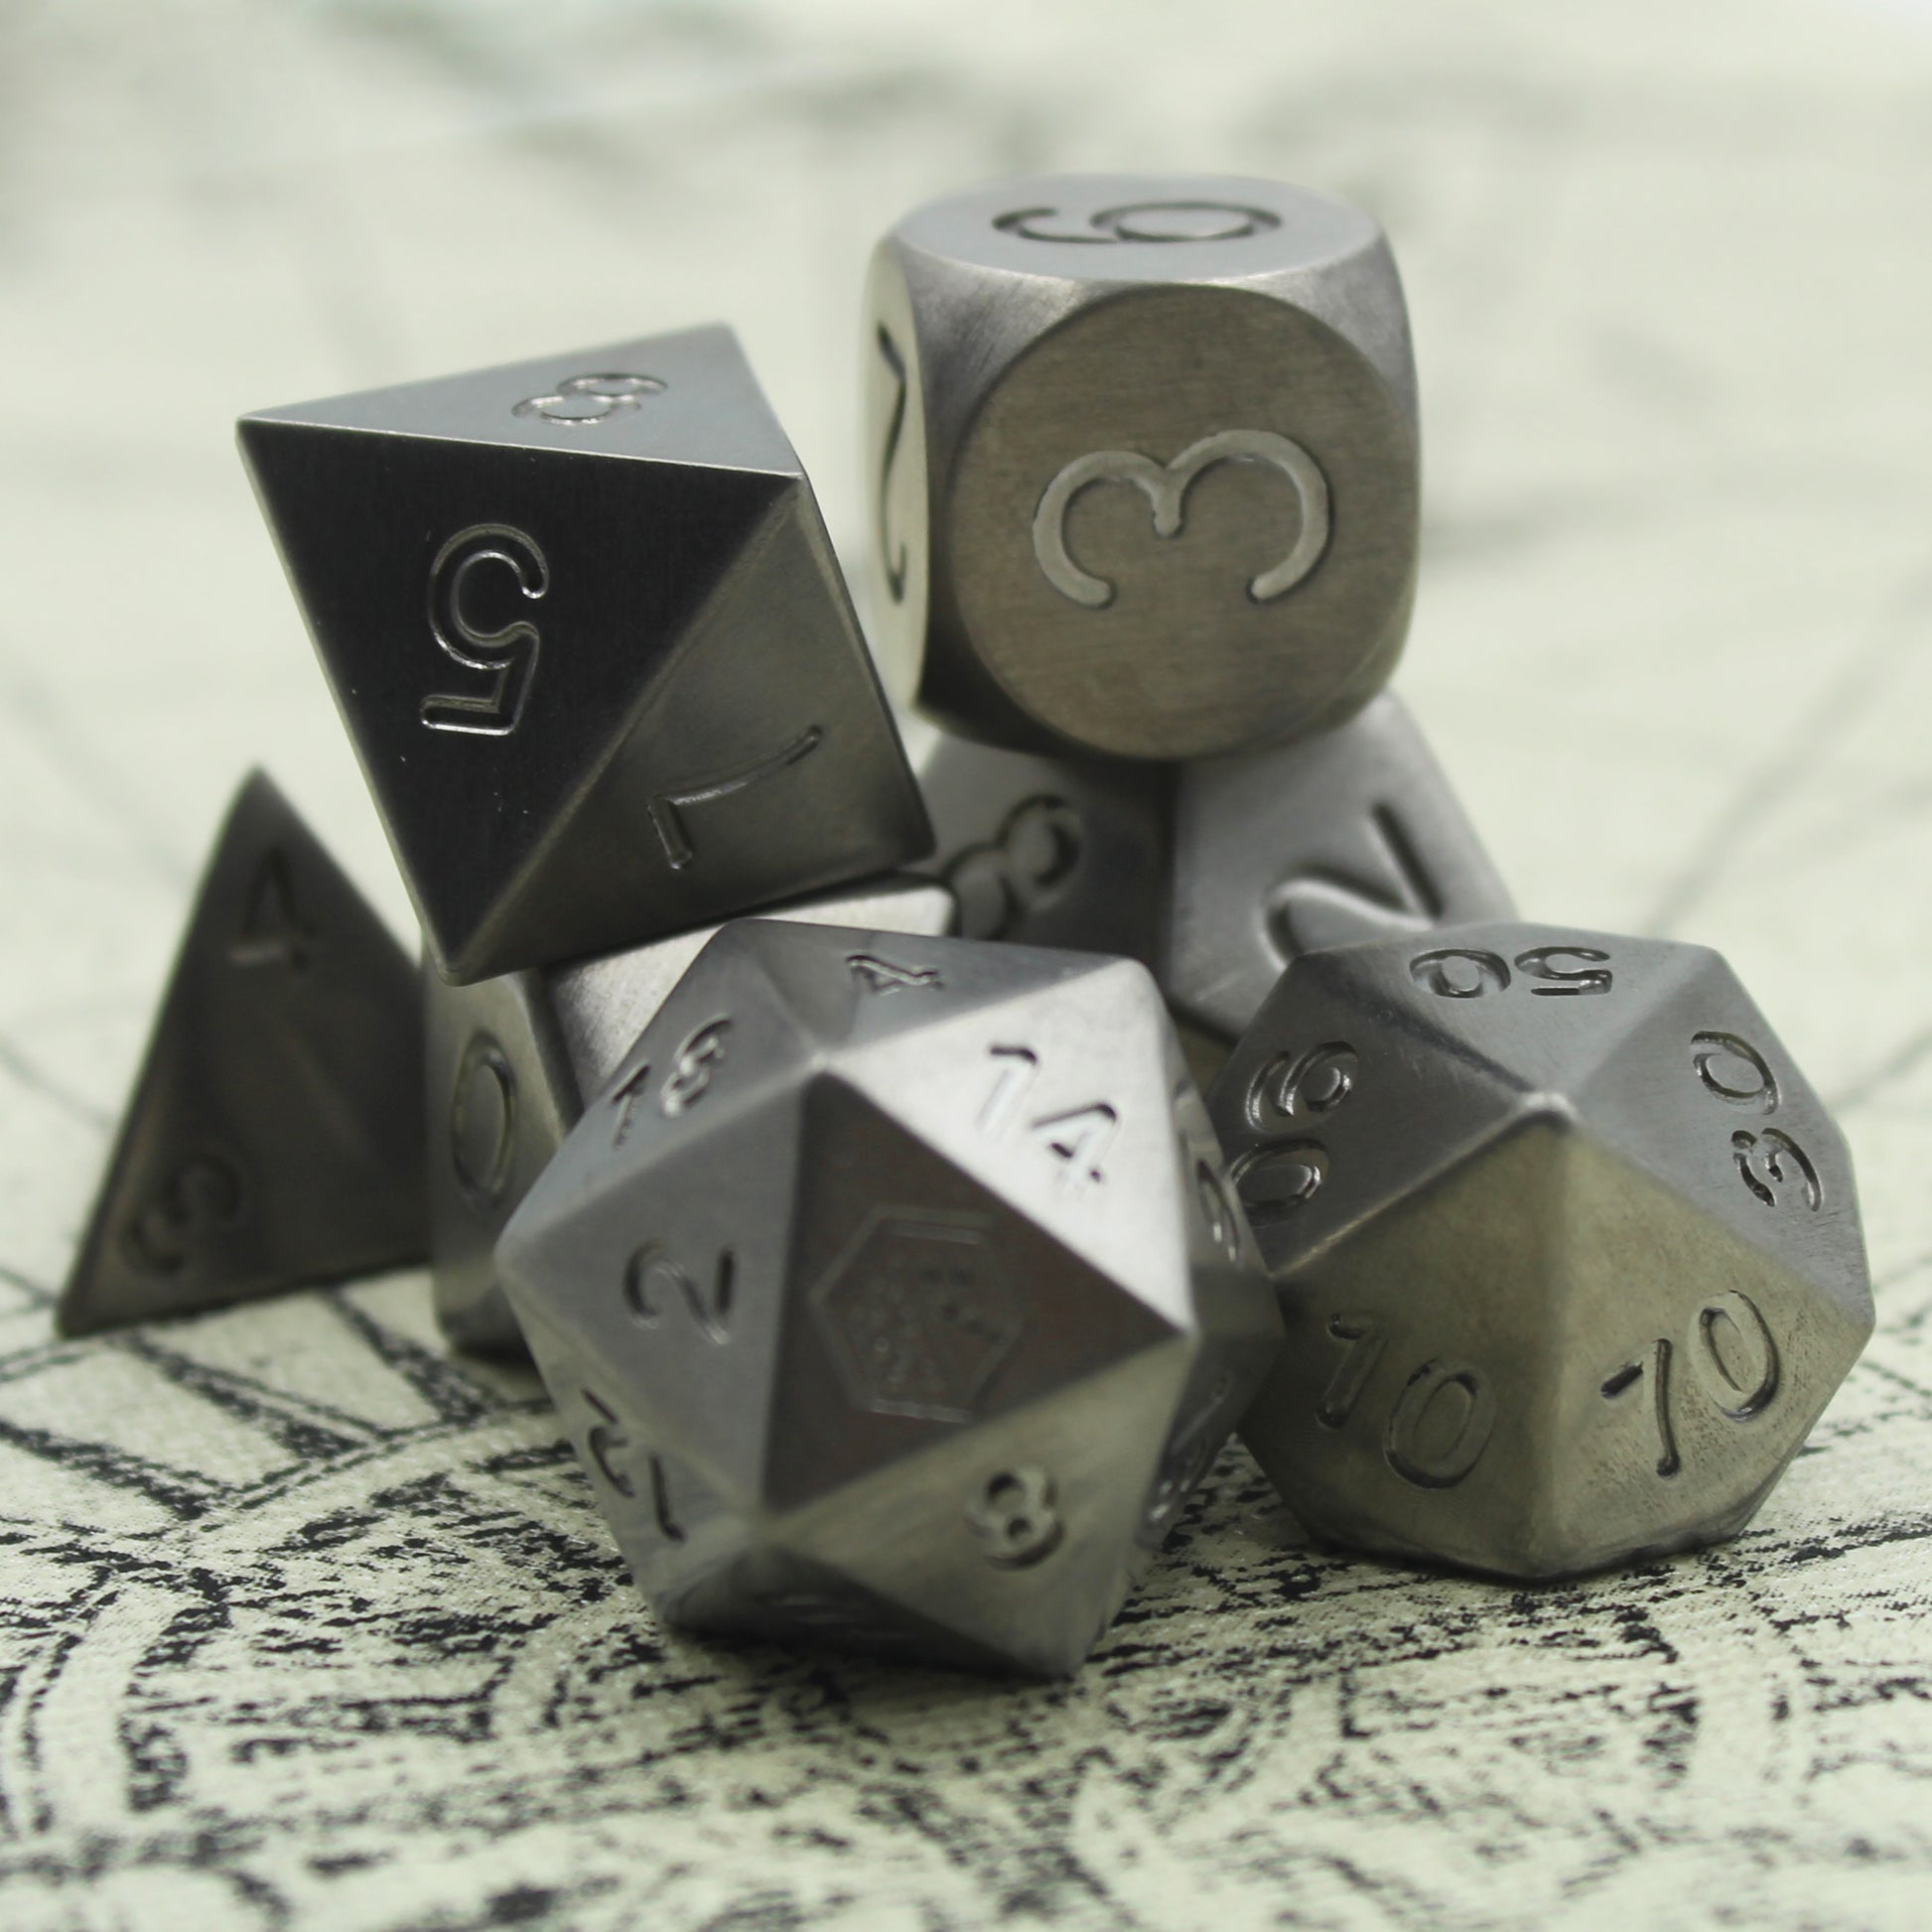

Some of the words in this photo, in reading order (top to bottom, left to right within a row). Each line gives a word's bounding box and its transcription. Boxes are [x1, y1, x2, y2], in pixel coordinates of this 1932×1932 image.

[991, 200, 1284, 245] 6
[510, 371, 669, 426] 8
[1033, 428, 1335, 610] 3
[419, 523, 550, 737] 5
[646, 723, 824, 871] 7
[1407, 944, 1615, 999] 50
[974, 1041, 1123, 1198] 14
[622, 1237, 738, 1348] 2
[1314, 1311, 1495, 1491] 10
[963, 1461, 1066, 1572] 8
